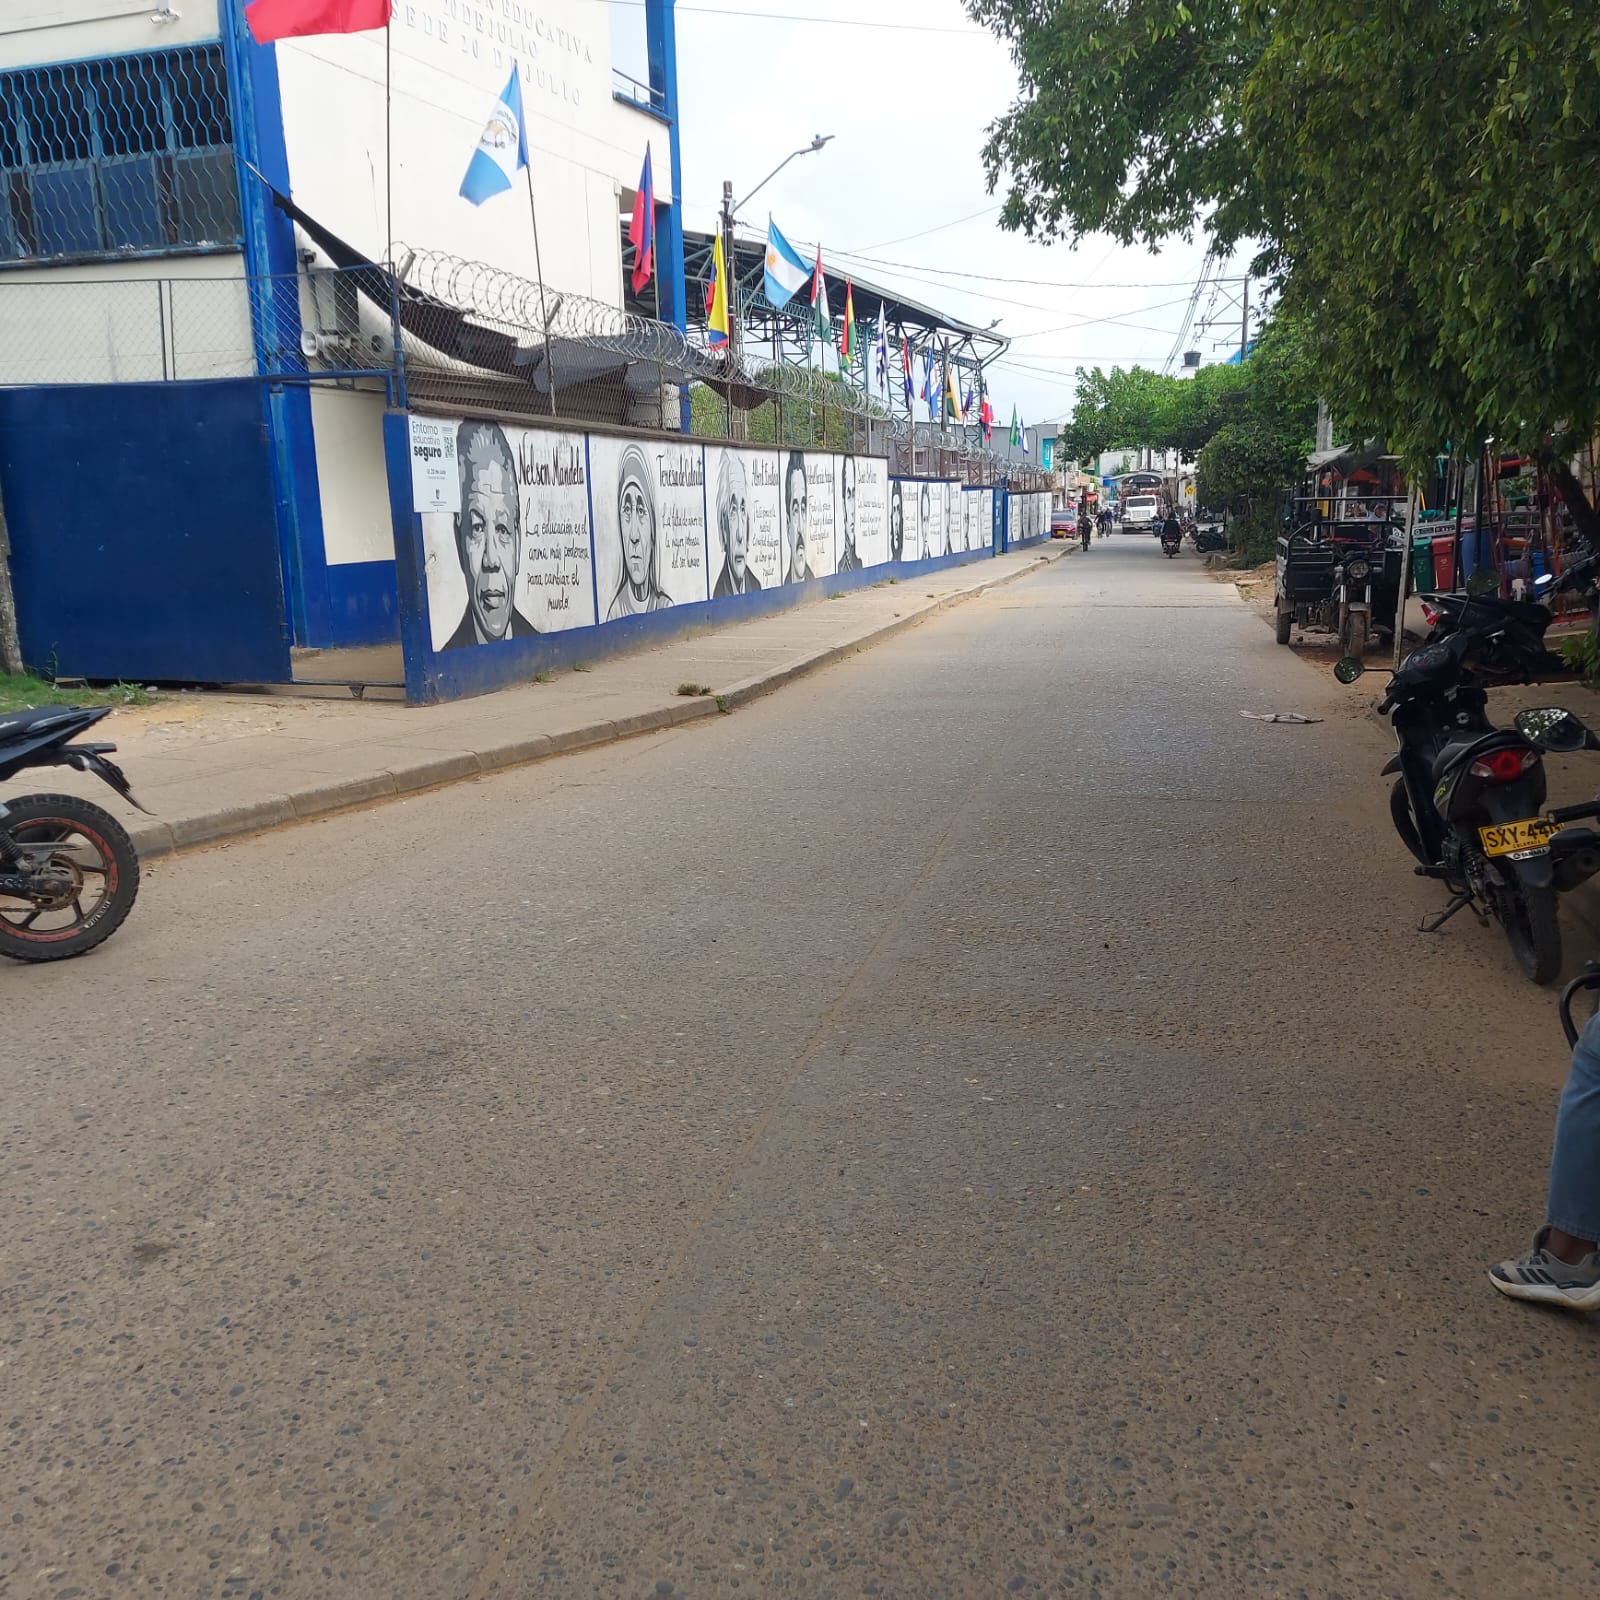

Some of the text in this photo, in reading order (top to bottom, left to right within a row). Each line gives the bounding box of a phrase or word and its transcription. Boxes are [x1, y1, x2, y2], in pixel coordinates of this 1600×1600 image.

[501, 0, 592, 63] EDUCATIVA
[461, 34, 478, 59] 20
[525, 64, 580, 107] JULIO
[412, 421, 439, 435] Entorno
[413, 446, 442, 462] seguro
[518, 432, 584, 486] Nelson Mandela
